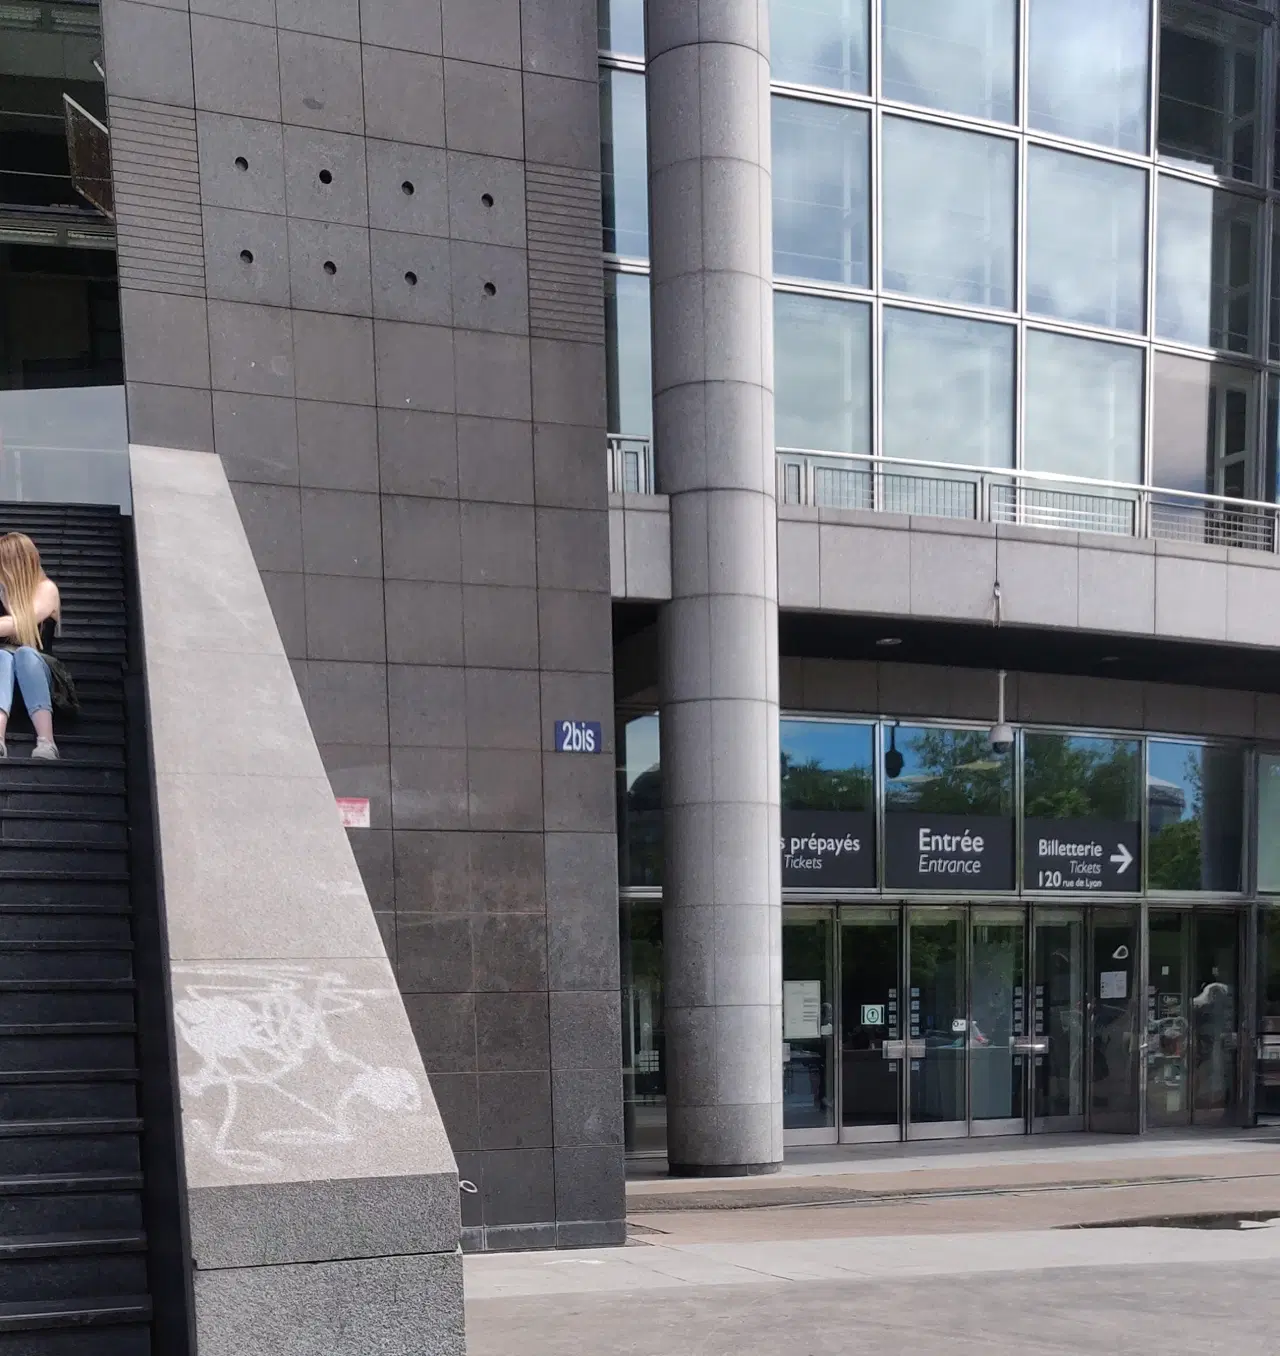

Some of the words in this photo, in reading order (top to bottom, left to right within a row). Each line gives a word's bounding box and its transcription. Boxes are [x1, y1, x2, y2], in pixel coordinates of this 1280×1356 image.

[562, 721, 595, 752] 2bis
[791, 833, 860, 856] prépayés
[918, 828, 984, 852] Entrée
[1038, 839, 1102, 857] Billetterie
[784, 855, 822, 870] Tickets
[918, 854, 981, 873] Entrance
[1069, 860, 1101, 874] Tickets
[1039, 871, 1061, 887] 120
[1063, 879, 1074, 887] rue
[1076, 878, 1084, 887] de
[1086, 878, 1102, 889] Lyon
